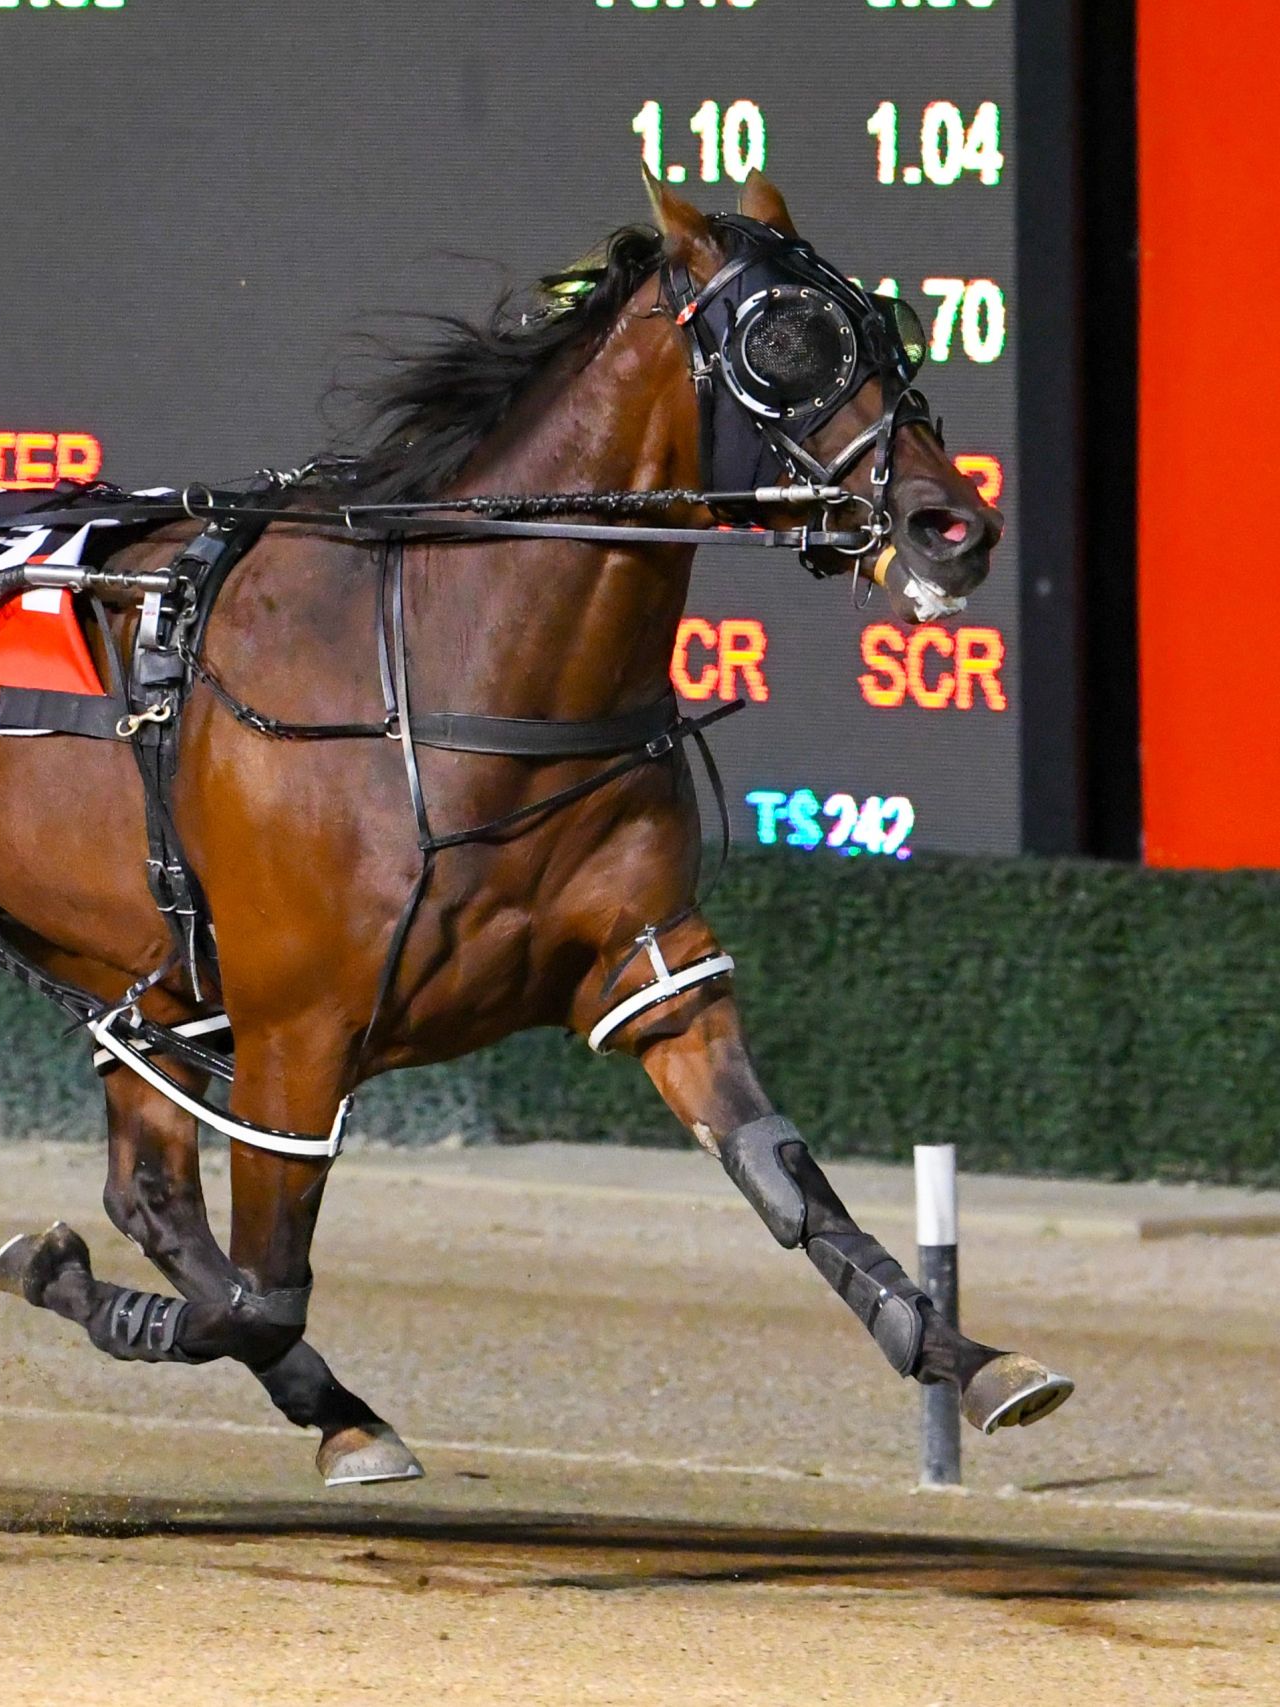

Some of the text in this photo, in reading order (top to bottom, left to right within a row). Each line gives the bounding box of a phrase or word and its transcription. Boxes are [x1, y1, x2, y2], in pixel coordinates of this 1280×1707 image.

[633, 100, 1003, 185] 1.10 1.04
[670, 618, 1007, 711] CR SCR
